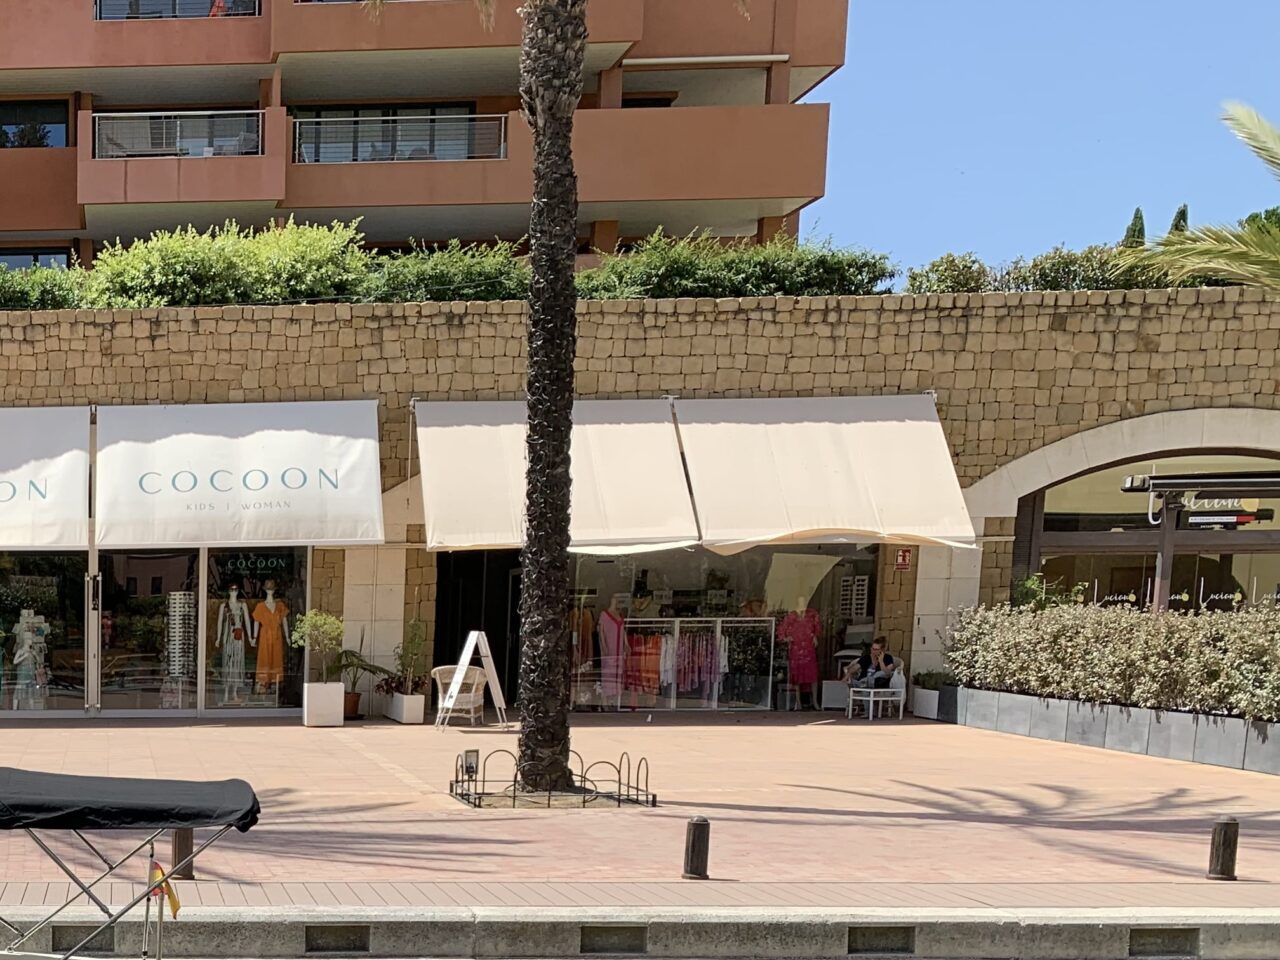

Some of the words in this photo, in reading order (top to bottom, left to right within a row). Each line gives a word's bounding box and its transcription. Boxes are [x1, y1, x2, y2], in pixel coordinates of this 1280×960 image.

[138, 467, 338, 495] COCOON
[186, 503, 216, 511] KIDS
[241, 501, 291, 510] WOMAN
[228, 559, 286, 569] COCOON
